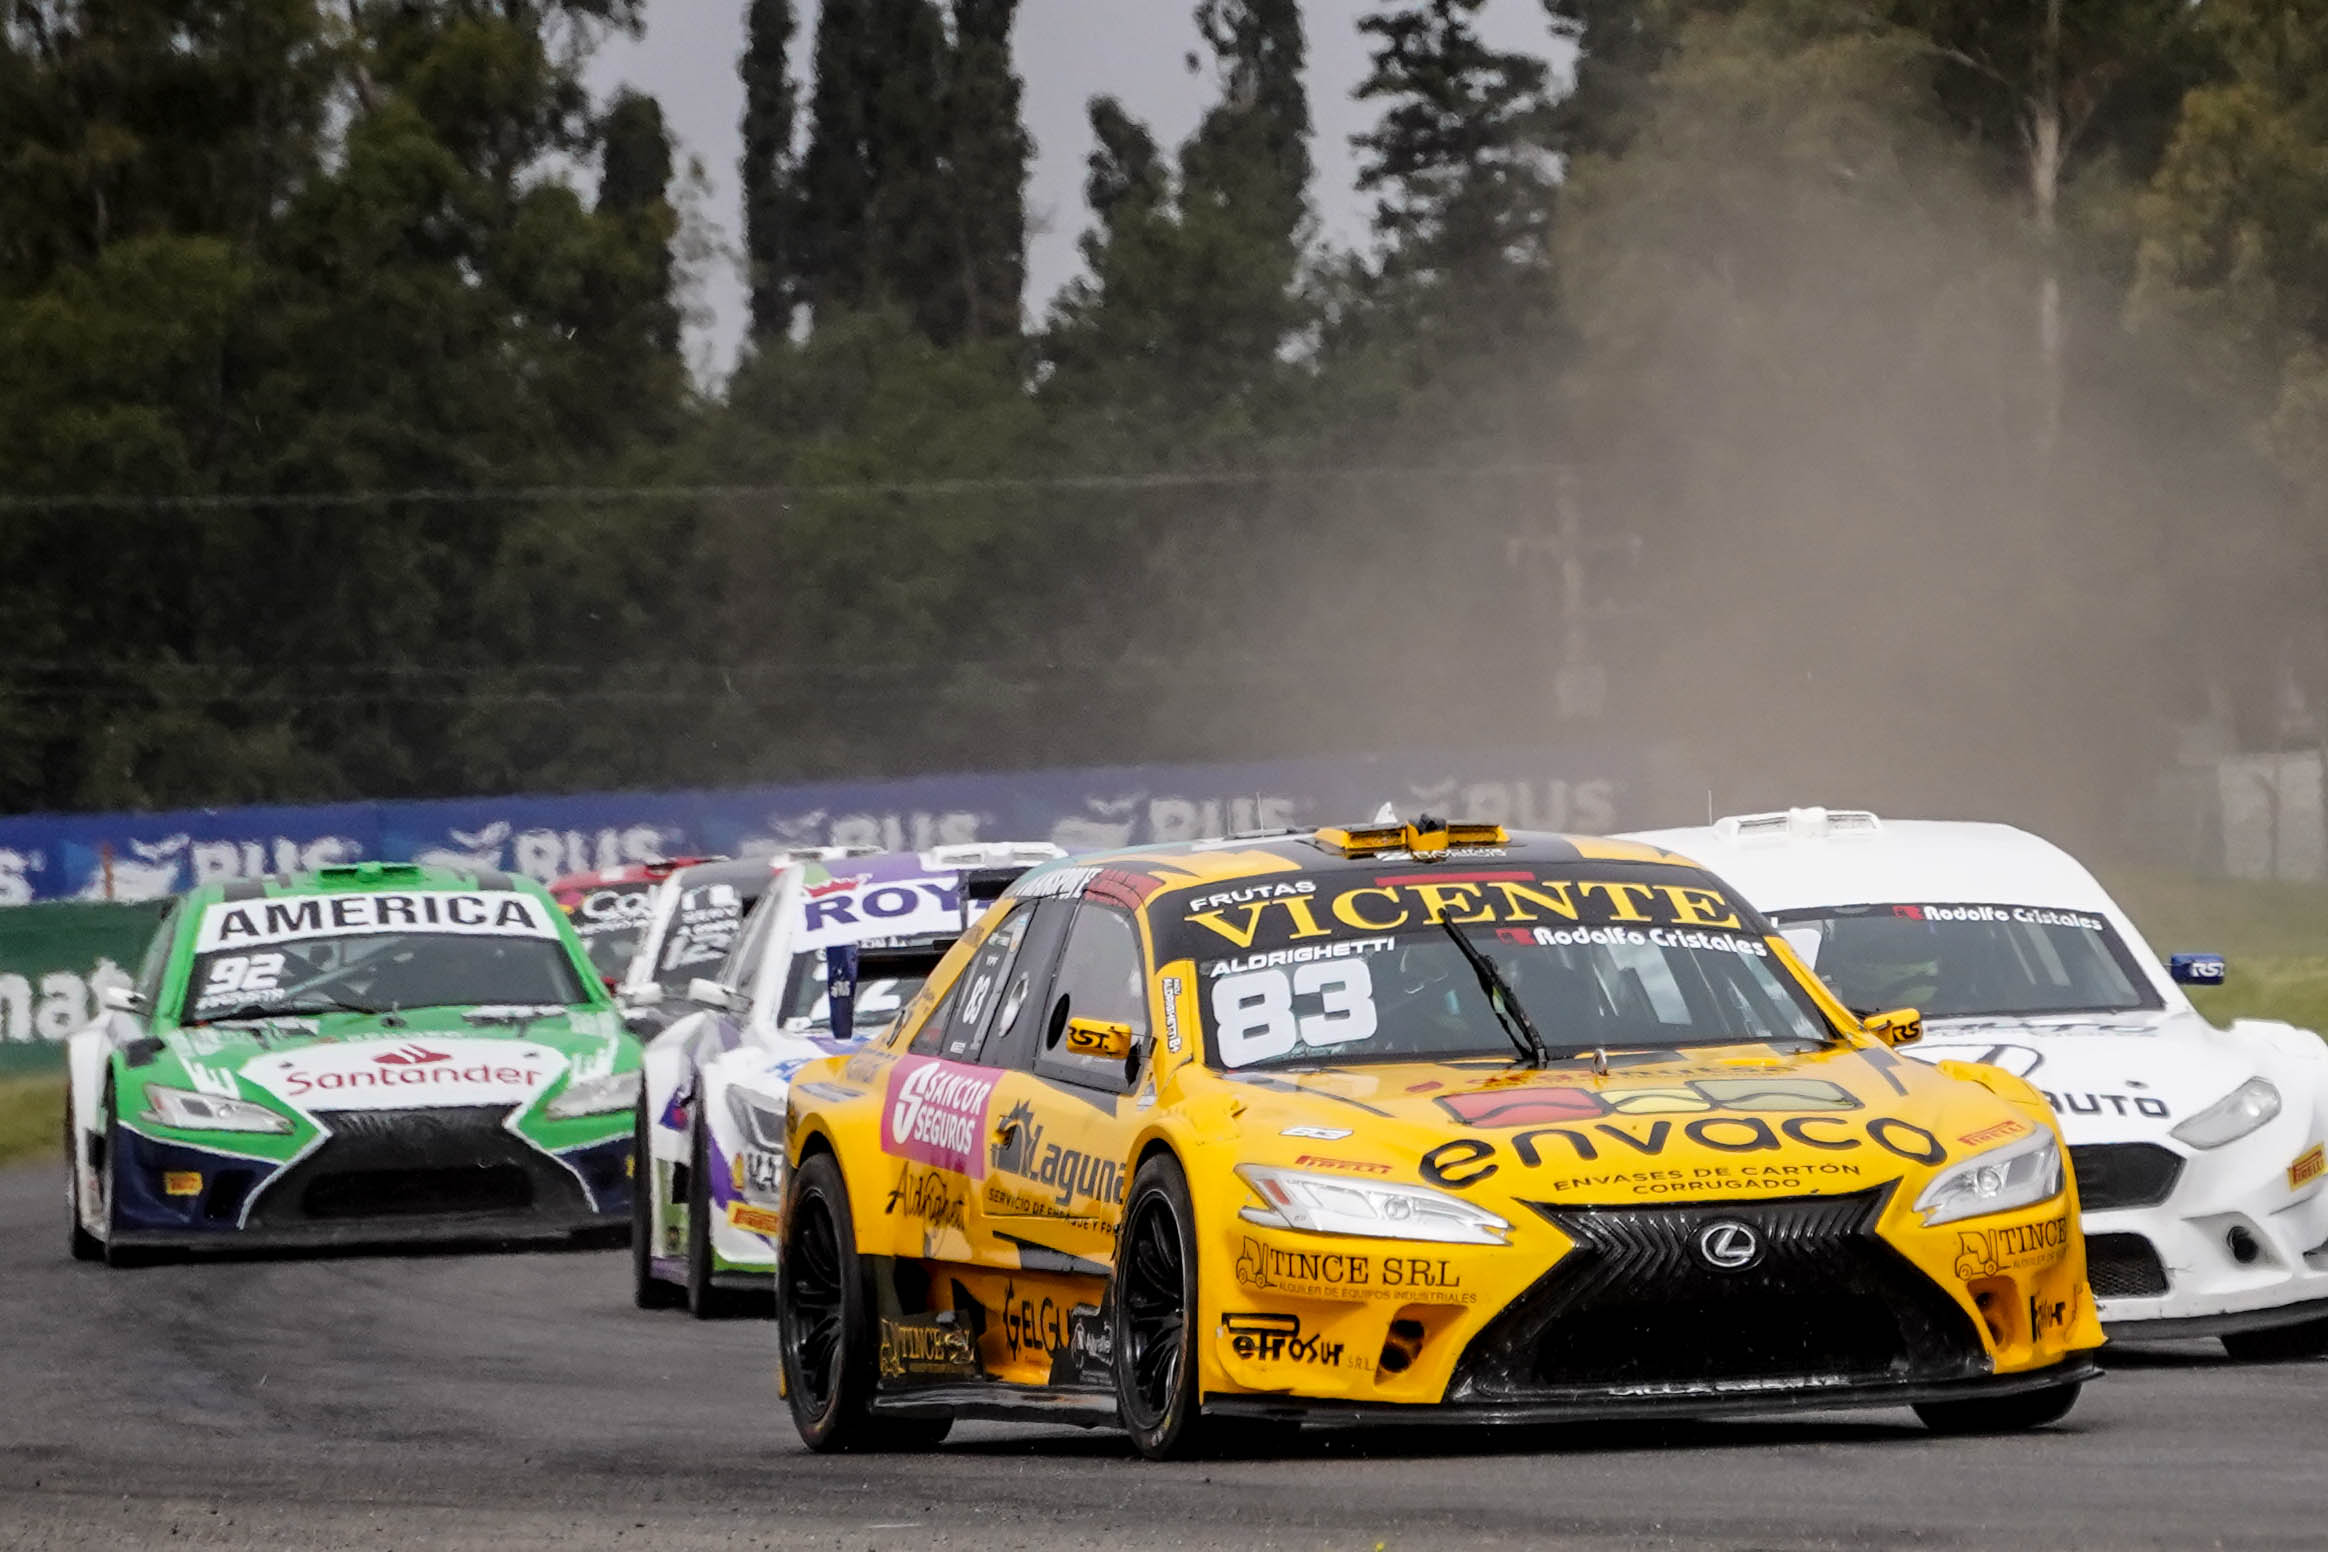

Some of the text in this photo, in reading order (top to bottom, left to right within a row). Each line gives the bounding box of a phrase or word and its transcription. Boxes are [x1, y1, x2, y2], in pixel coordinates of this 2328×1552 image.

[1184, 881, 1741, 948] VICENTE
[1190, 880, 1317, 912] FRUTAS
[219, 897, 537, 941] AMERICA
[1924, 906, 2103, 931] Rodolfo Cristales
[1210, 936, 1395, 978] ALDRIGHETTI
[1533, 926, 1768, 957] Rodolfo Cristales
[206, 953, 286, 994] 92
[1211, 957, 1378, 1068] 83
[286, 1063, 542, 1097] Santander
[925, 1071, 992, 1116] SANCOR
[913, 1108, 976, 1155] SEGUROS
[1957, 1119, 2024, 1147] PIRELLI
[1295, 1155, 1392, 1174] PIRELLI
[1419, 1117, 1948, 1190] envaco
[1553, 1162, 1860, 1192] ENVASES DE CARTÓN
[1633, 1178, 1801, 1195] CORRUGADO
[988, 1187, 1030, 1212] SERVICIO
[2000, 1218, 2067, 1256] TINCE
[1271, 1249, 1460, 1287] TINCE SRL
